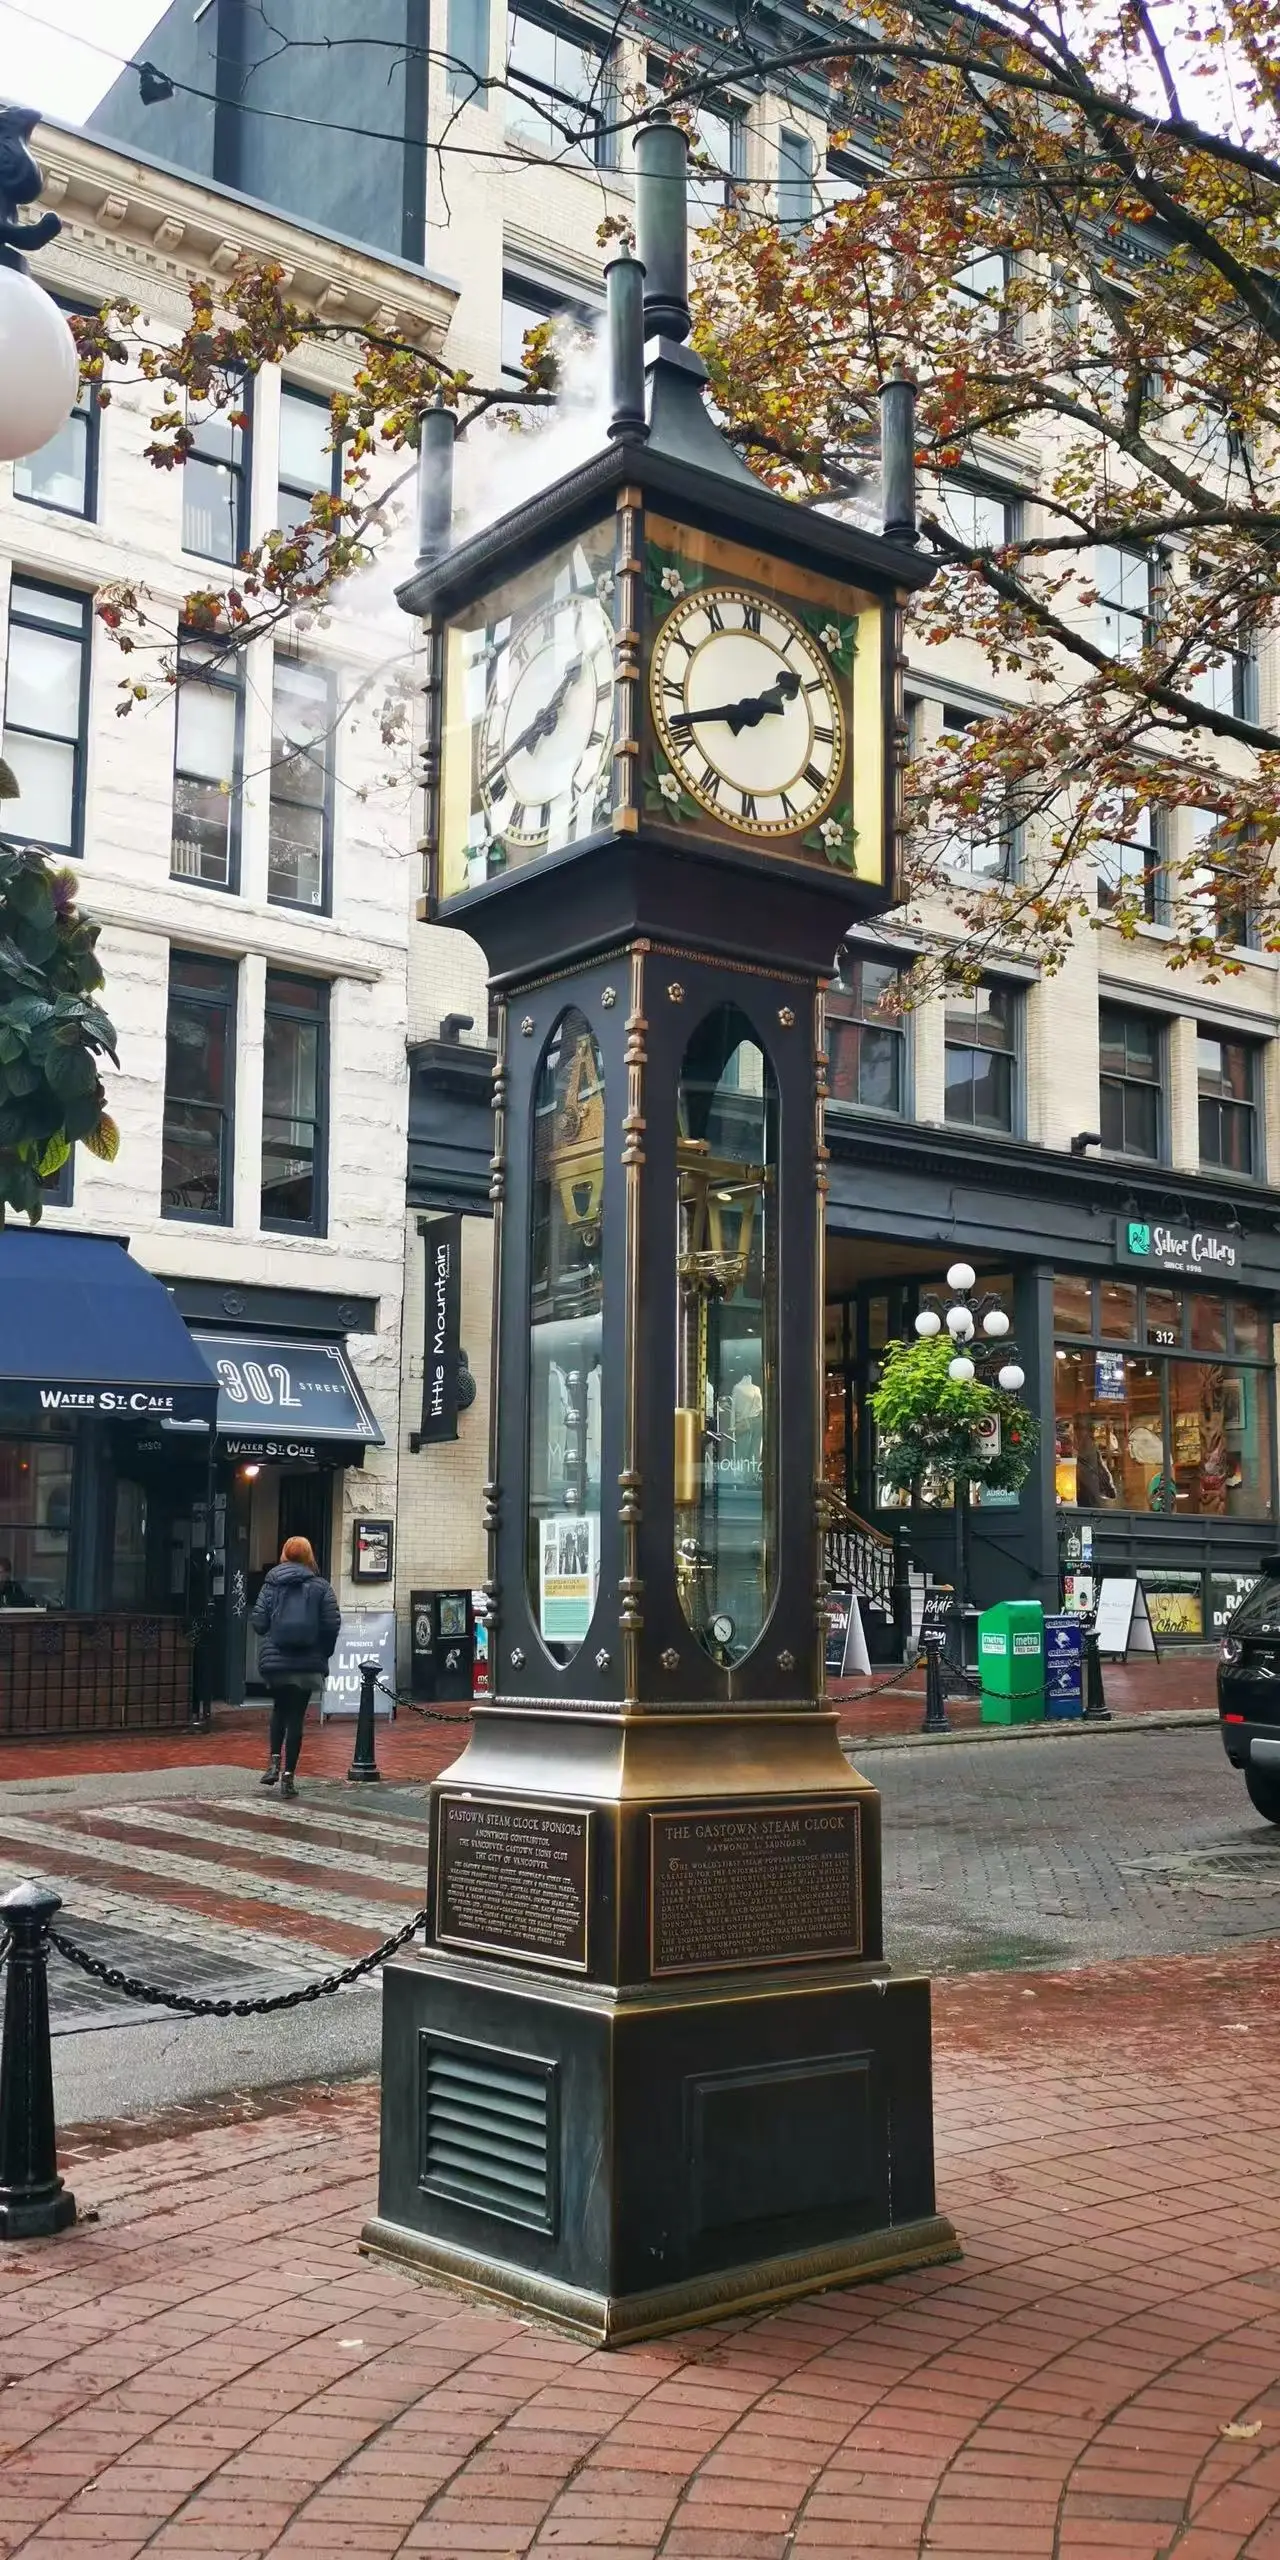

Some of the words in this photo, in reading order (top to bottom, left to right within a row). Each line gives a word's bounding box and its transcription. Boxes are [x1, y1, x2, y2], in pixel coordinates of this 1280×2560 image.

[1153, 1227, 1189, 1256] Silver
[1191, 1233, 1236, 1267] Gallery
[1163, 1261, 1184, 1271] SINCE
[432, 1244, 448, 1354] Mountain
[1155, 1331, 1175, 1344] 312
[217, 1359, 302, 1407] 302
[298, 1381, 348, 1394] STREET
[430, 1364, 444, 1416] little
[40, 1390, 95, 1408] WATER
[130, 1393, 173, 1411] CAFE
[226, 1440, 263, 1454] WATER
[286, 1444, 315, 1458] CAFE
[984, 1635, 1004, 1644] metro
[1015, 1635, 1038, 1646] metro
[448, 1810, 484, 1822] GASTOWN
[486, 1814, 511, 1826] STEAM
[513, 1818, 539, 1830] CLOCK
[542, 1822, 581, 1836] SPONSORS
[665, 1826, 690, 1840] THE
[695, 1822, 758, 1838] GASTOWN
[761, 1820, 799, 1834] STEAM
[804, 1817, 844, 1831] CLOCK
